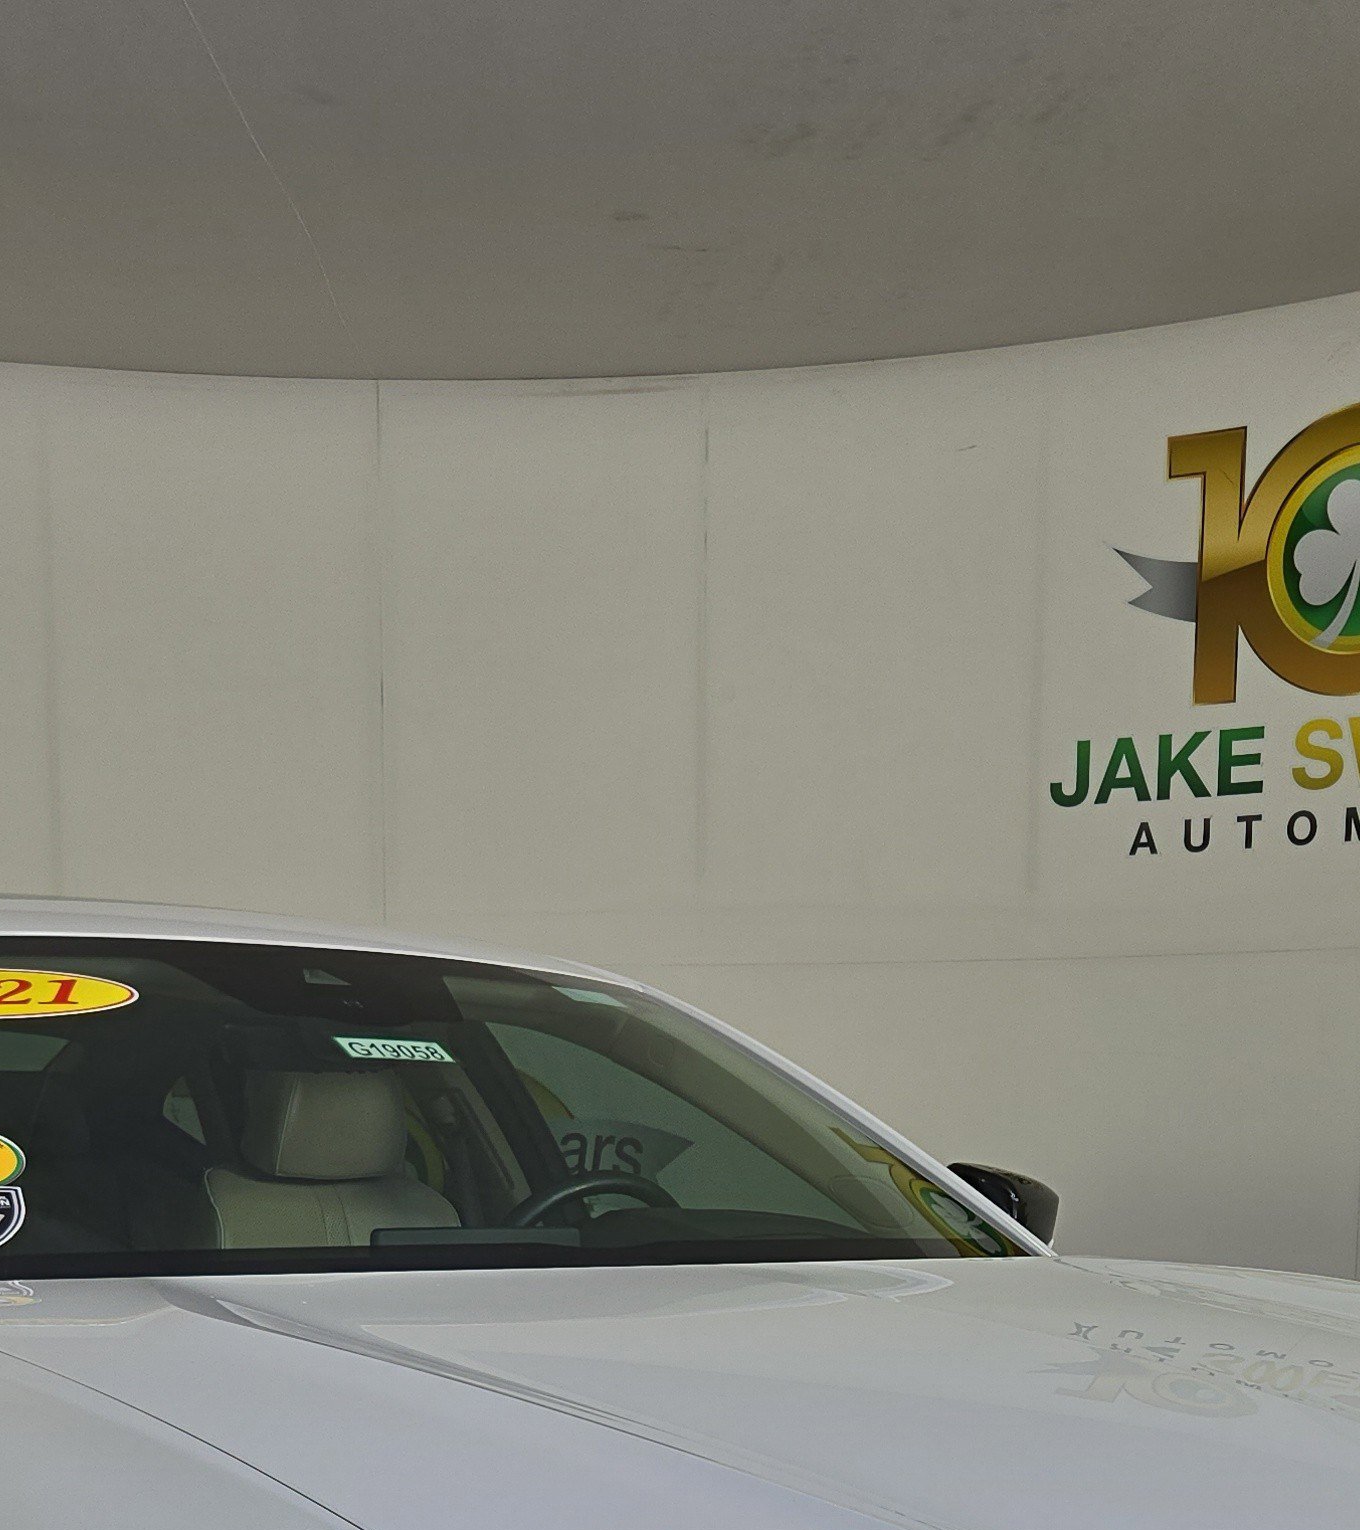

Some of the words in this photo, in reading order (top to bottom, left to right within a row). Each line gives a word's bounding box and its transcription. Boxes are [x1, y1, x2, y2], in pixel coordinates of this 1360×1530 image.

[1050, 726, 1265, 807] JAKE
[348, 1041, 445, 1061] G19058
[560, 1132, 643, 1174] ars
